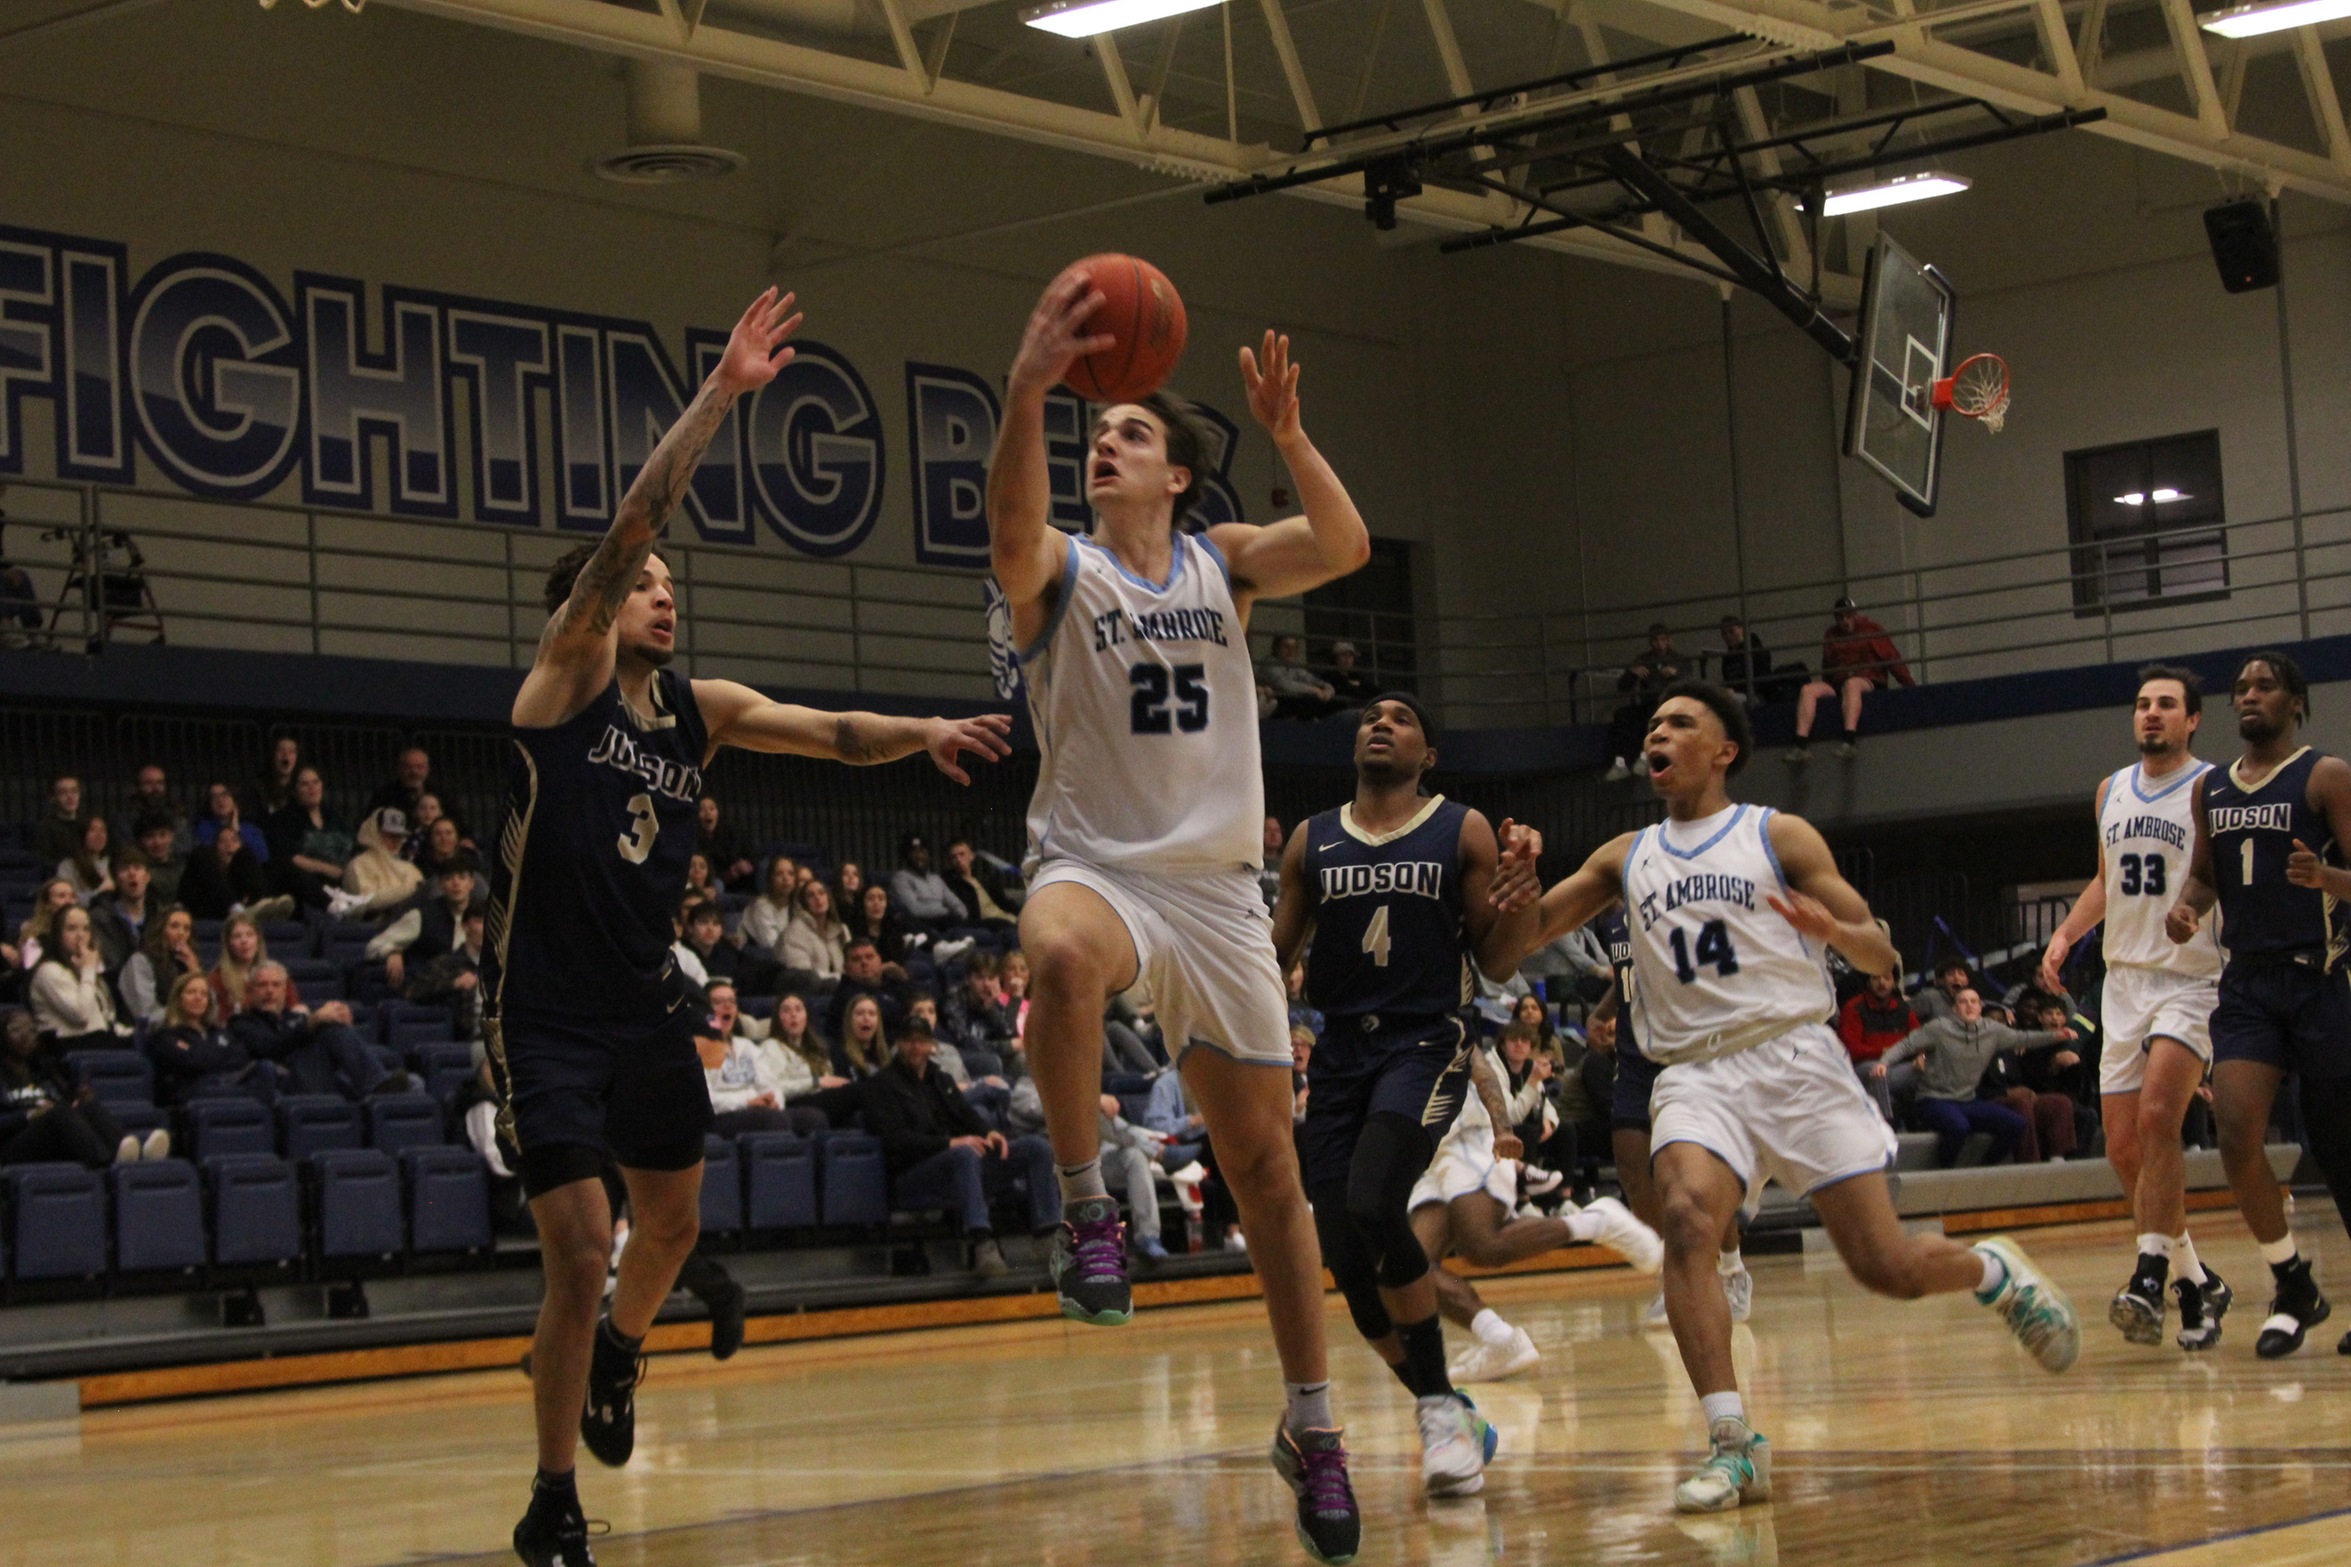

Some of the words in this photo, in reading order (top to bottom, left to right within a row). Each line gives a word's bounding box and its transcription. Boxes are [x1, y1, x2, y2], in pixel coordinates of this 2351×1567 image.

[1094, 609, 1125, 652] ST.
[1130, 607, 1228, 648] AMBROE
[1129, 662, 1210, 735] 25
[588, 724, 702, 802] JUSON
[617, 793, 659, 865] 3
[2106, 822, 2120, 849] ST.
[2124, 816, 2186, 851] AMBROSE
[2208, 803, 2291, 837] JUDSON
[1320, 861, 1442, 904] JUDSON
[2120, 853, 2166, 895] 33
[2240, 838, 2254, 885] 1
[1666, 874, 1755, 911] AMBROSE
[1362, 905, 1391, 967] 4
[1670, 919, 1739, 985] 14
